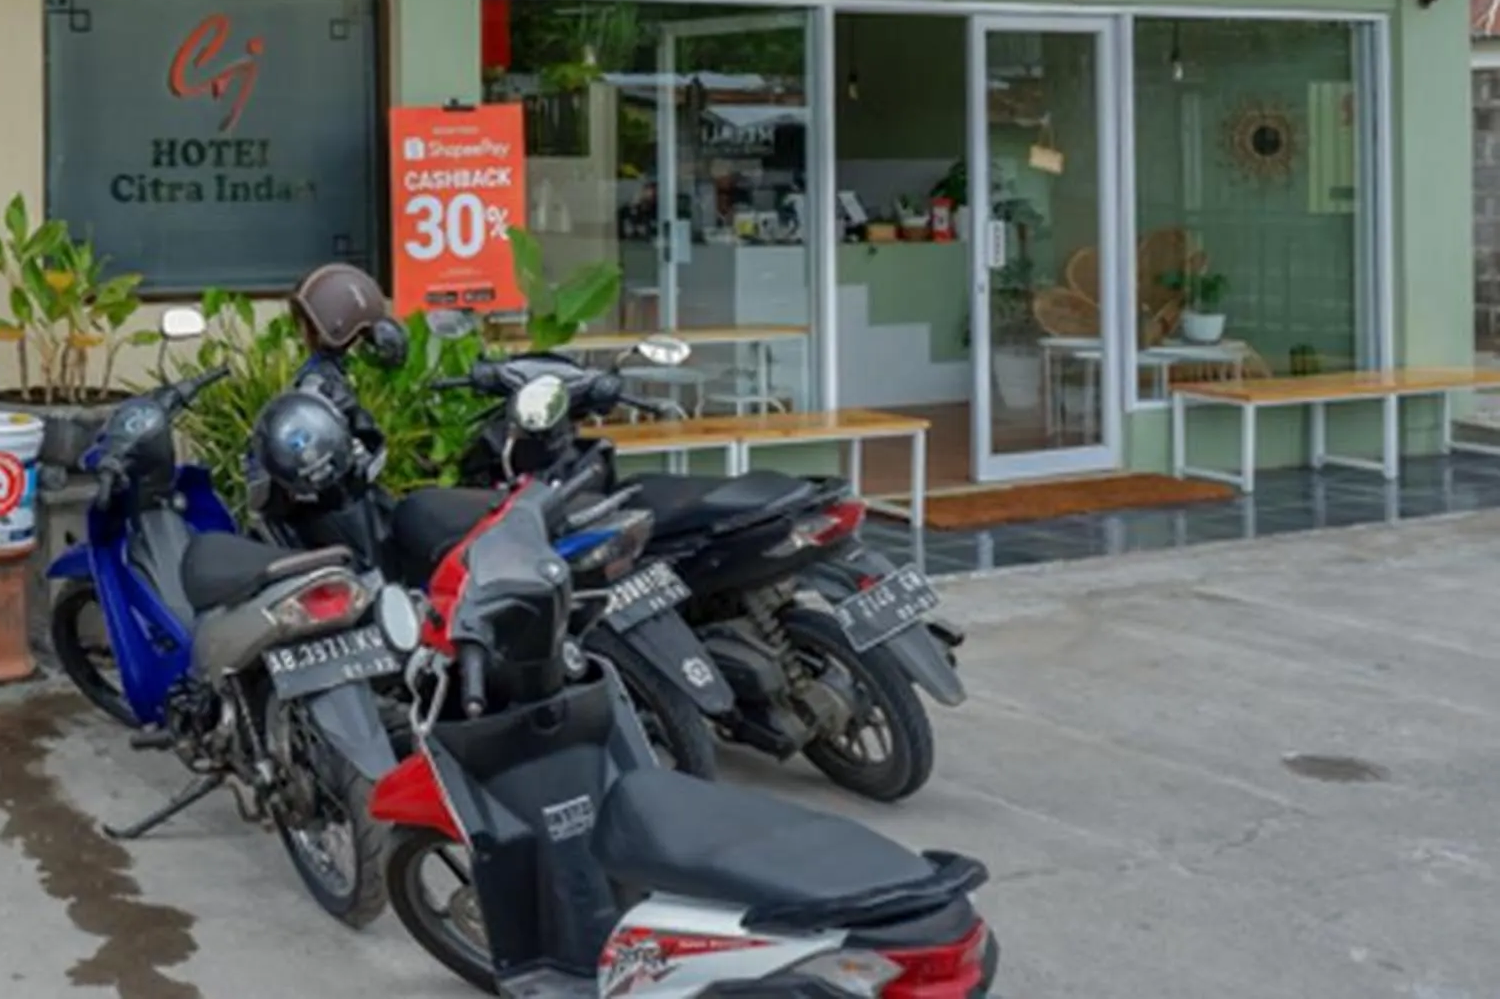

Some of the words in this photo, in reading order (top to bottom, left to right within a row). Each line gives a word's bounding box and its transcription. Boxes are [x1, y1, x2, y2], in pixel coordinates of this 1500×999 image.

[110, 173, 204, 203] Citra
[214, 174, 318, 203] Inda
[405, 167, 512, 191] CASHBACK
